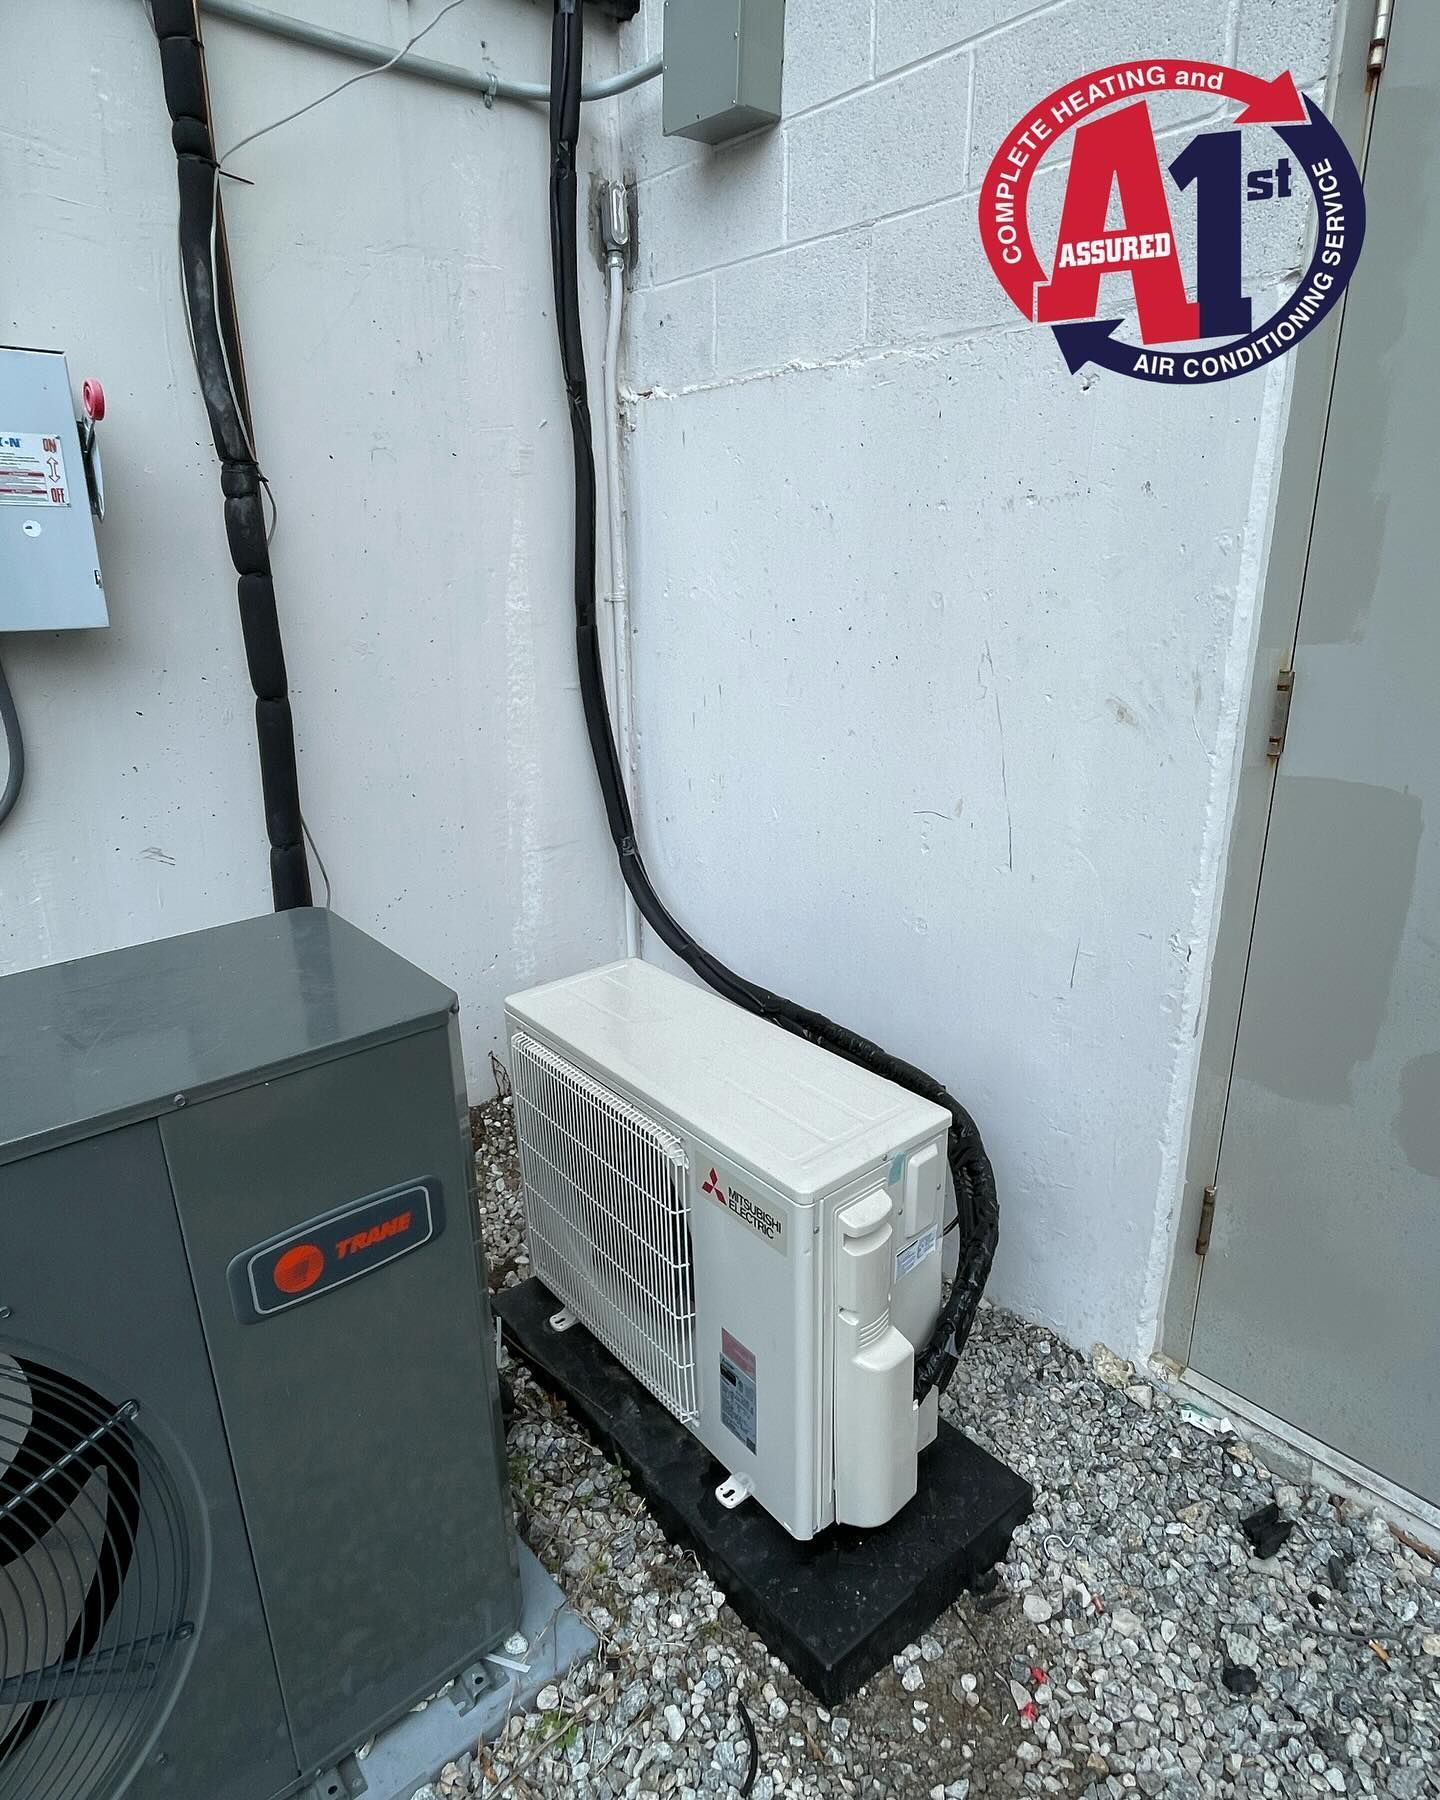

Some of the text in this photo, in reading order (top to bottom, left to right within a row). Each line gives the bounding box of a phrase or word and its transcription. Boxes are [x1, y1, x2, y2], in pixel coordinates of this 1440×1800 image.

[42, 438, 57, 453] ON
[51, 488, 65, 503] OFF
[728, 1186, 782, 1234] MITSUBISHI
[728, 1199, 774, 1239] ELECTRIC
[335, 1210, 413, 1259] TRANE
